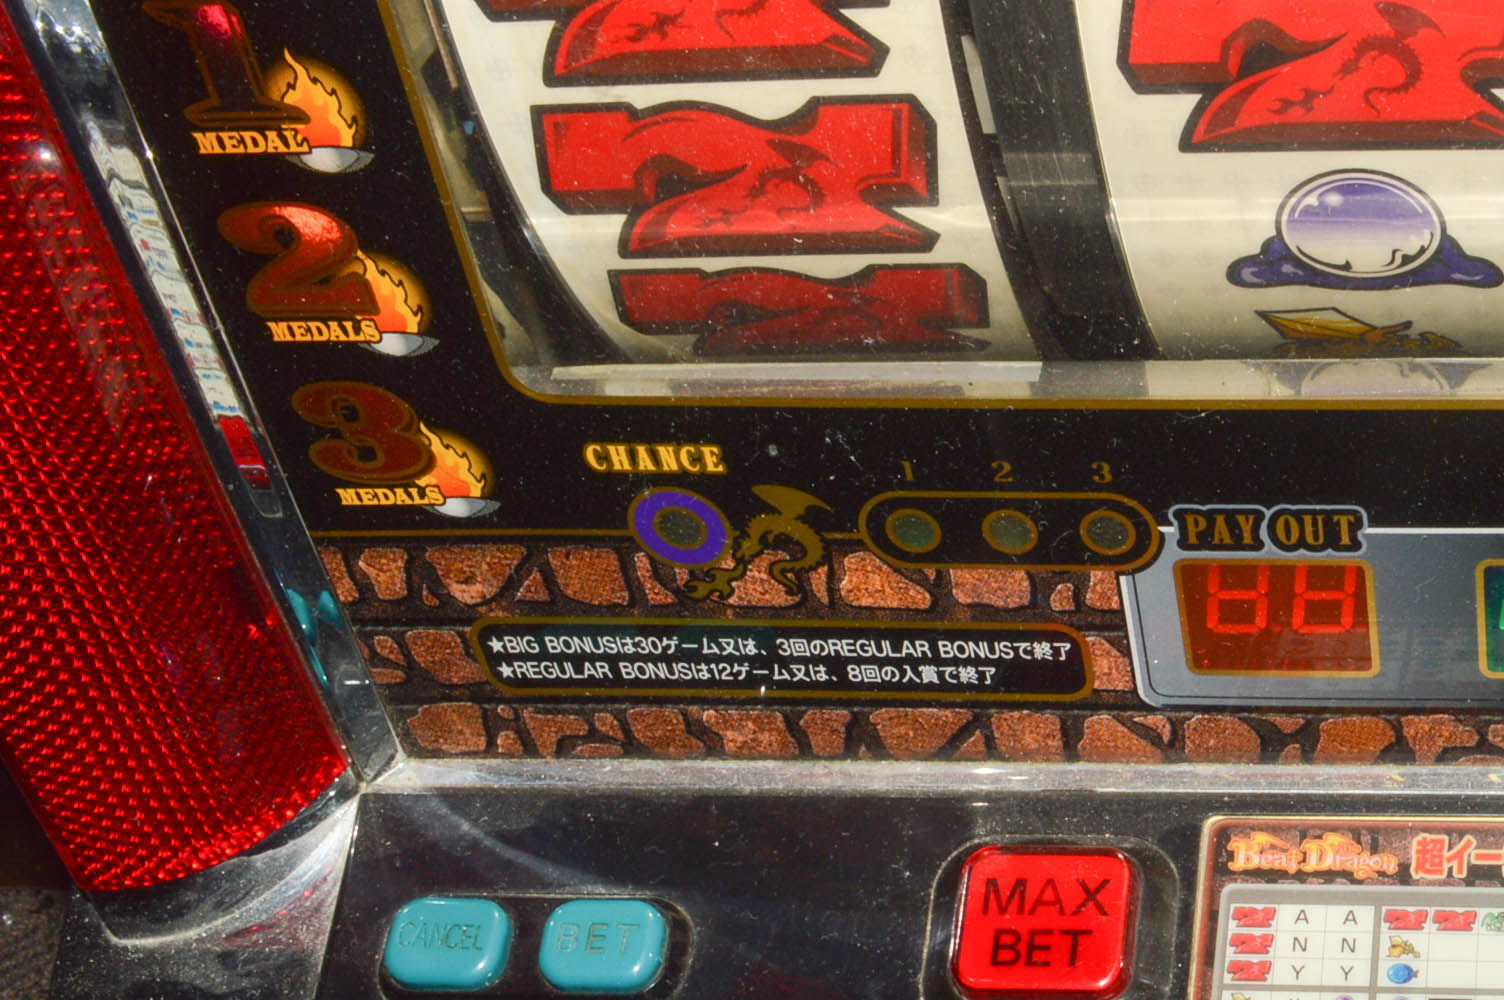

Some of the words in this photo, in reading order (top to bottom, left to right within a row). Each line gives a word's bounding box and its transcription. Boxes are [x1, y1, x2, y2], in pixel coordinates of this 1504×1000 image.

[191, 129, 310, 155] MEDAL
[217, 201, 381, 318] 2
[265, 319, 381, 342] MEDALS
[290, 380, 437, 485] 3
[583, 443, 727, 475] CHANCE
[903, 461, 916, 481] 1
[991, 461, 1014, 482] 2
[1091, 461, 1114, 483] 3
[335, 487, 446, 506] MEDALS
[1184, 513, 1256, 546] PAY
[1275, 513, 1356, 546] OUT
[981, 878, 1111, 918] MAX
[398, 922, 483, 951] CANCEL
[557, 922, 642, 953] BET
[990, 929, 1093, 969] BET
